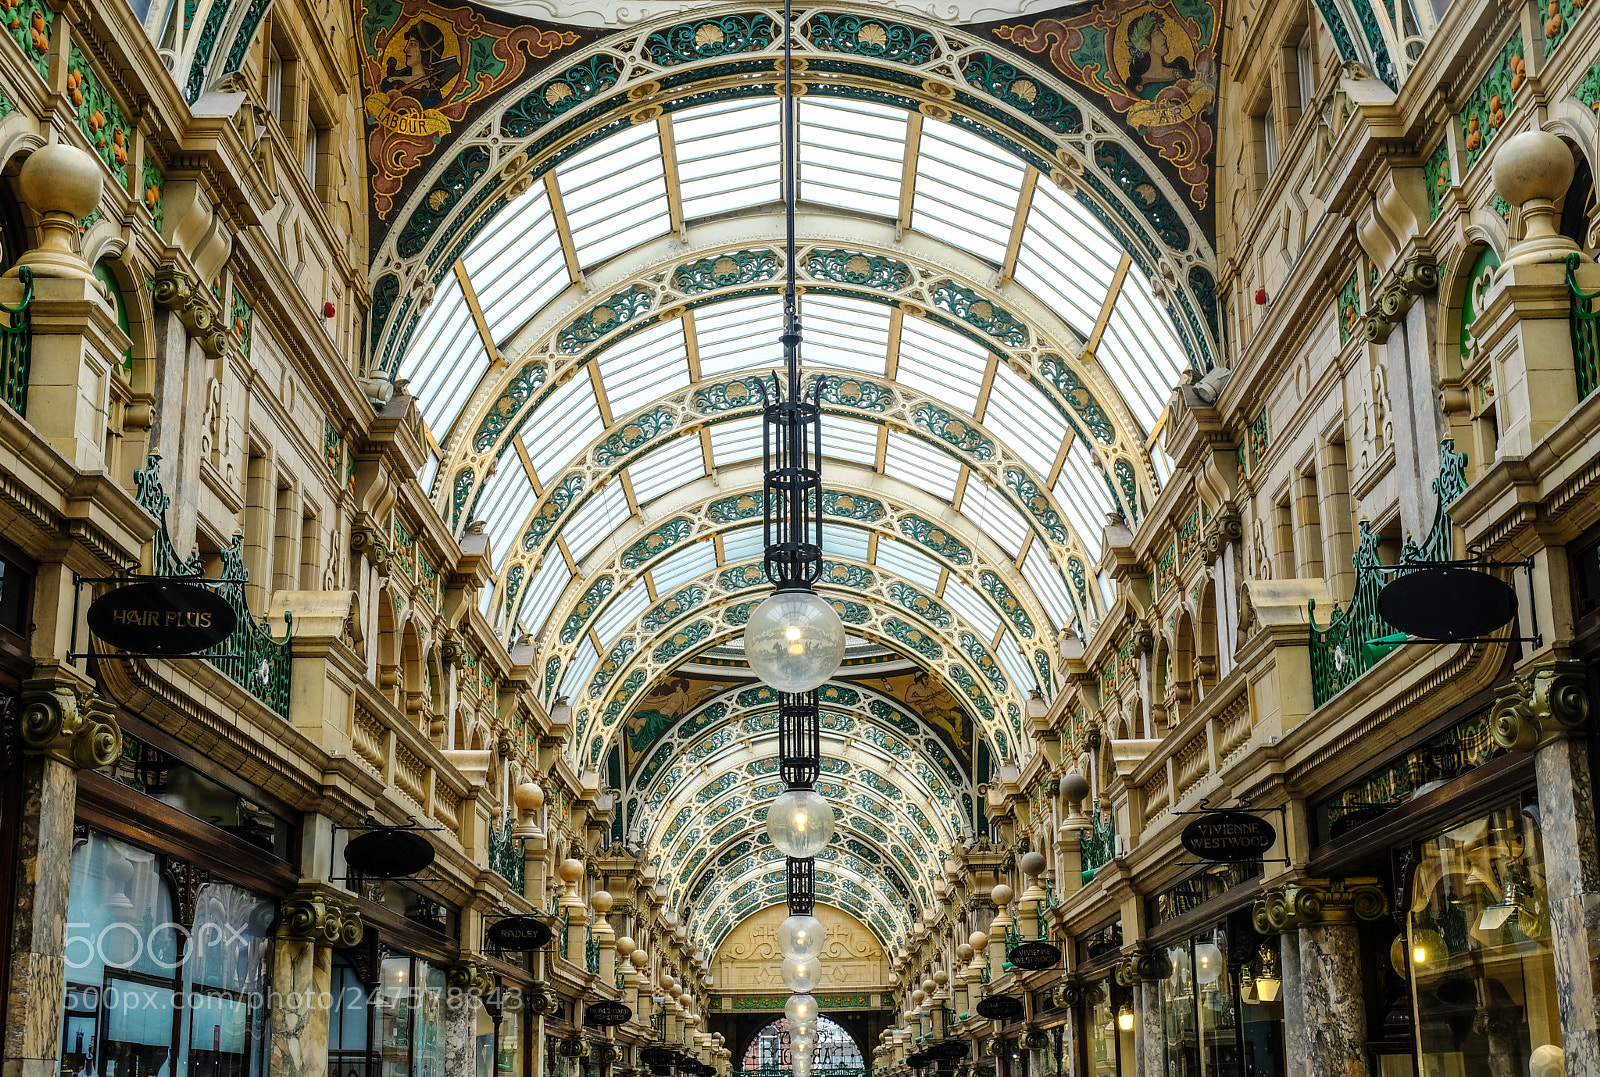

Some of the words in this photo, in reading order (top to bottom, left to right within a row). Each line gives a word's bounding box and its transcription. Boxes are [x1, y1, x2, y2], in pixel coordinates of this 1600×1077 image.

[377, 107, 428, 134] LABOUR
[1159, 101, 1195, 124] ART
[112, 609, 160, 627] HAIR
[165, 611, 212, 628] PLUS
[1198, 822, 1260, 836] VIVIENNE
[1190, 835, 1269, 849] WESTWOOD
[500, 929, 538, 938] RADLEY
